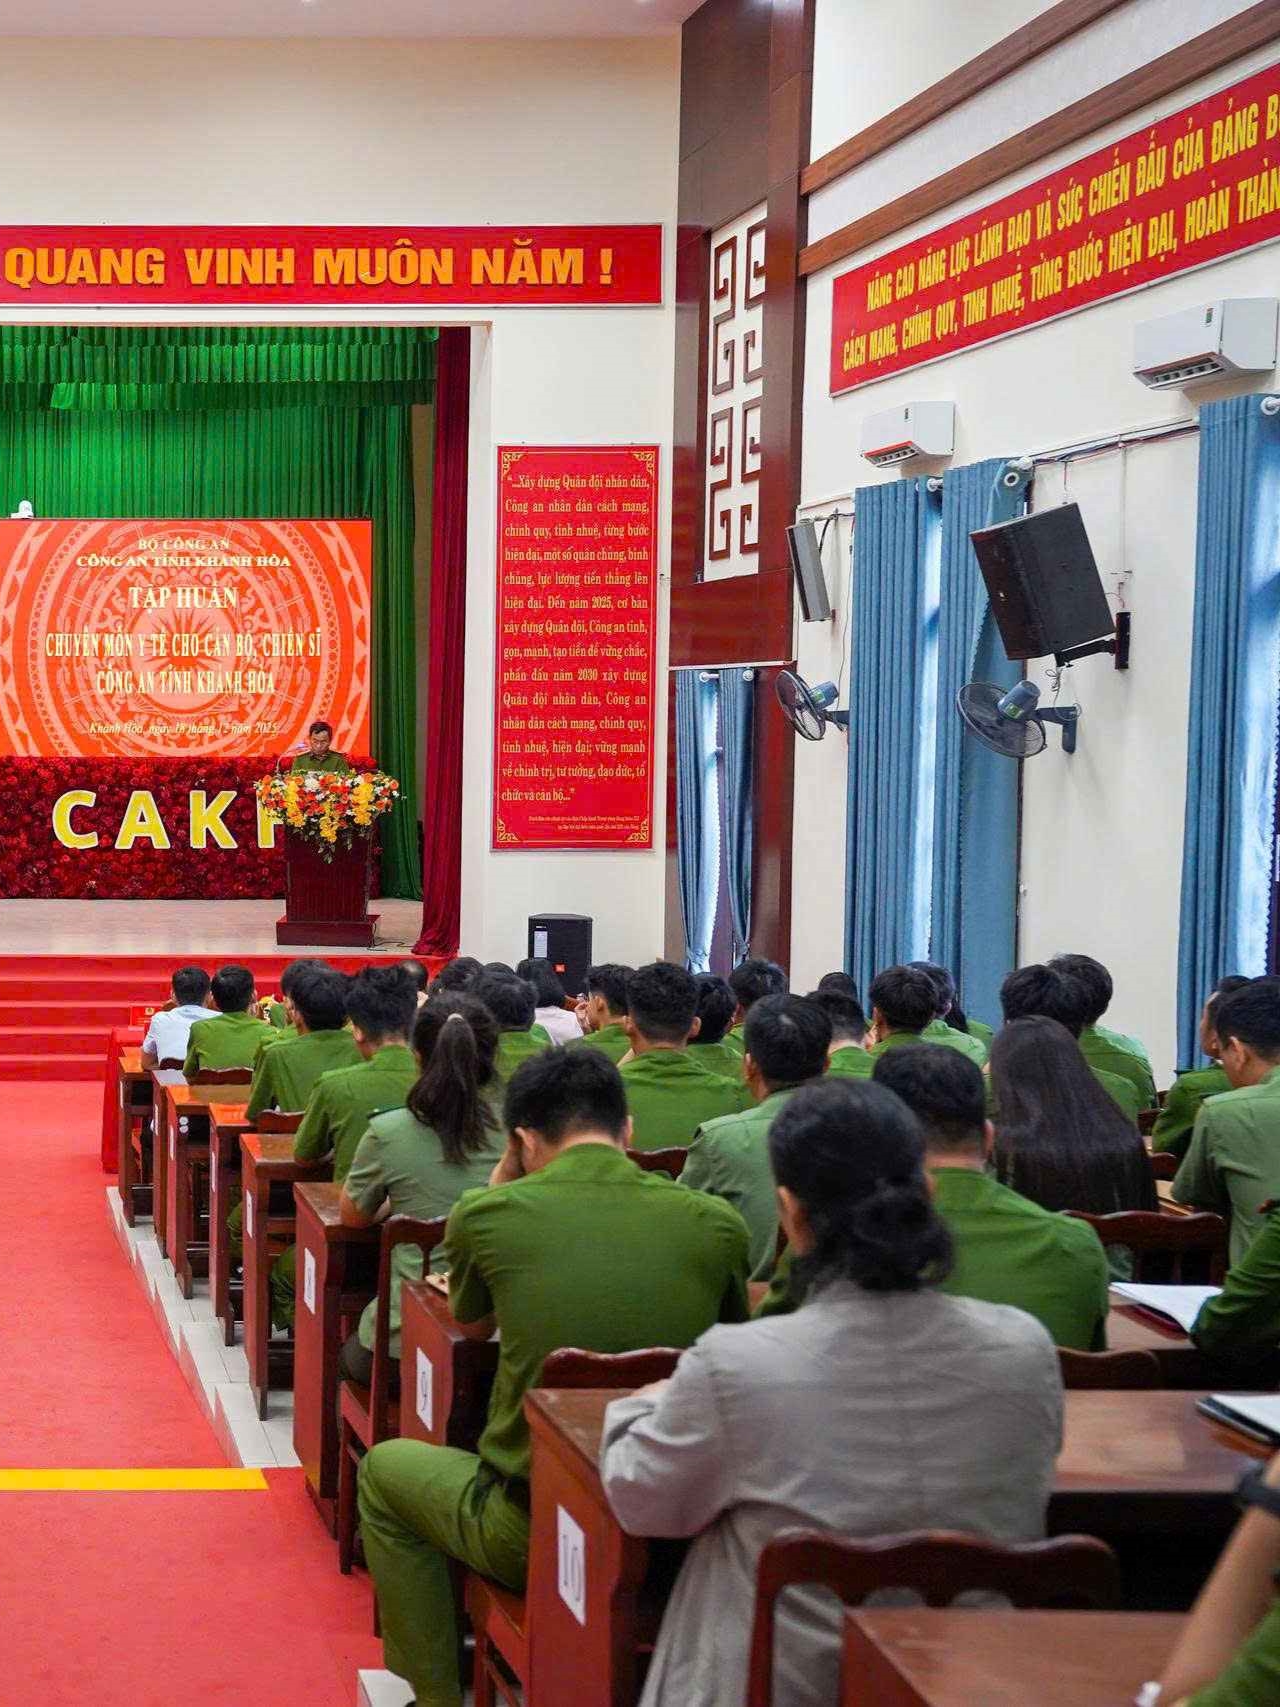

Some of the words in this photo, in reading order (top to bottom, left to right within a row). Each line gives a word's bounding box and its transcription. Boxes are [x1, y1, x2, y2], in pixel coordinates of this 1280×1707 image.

[896, 262, 915, 300] CAO
[949, 236, 970, 281] LỰC
[974, 220, 1003, 267] LÃNH
[1007, 209, 1031, 256] ĐẠO
[1036, 188, 1052, 240] VÀ
[1057, 177, 1084, 231] SỨC
[1088, 147, 1131, 217] CHIẾN
[1135, 129, 1167, 197] ĐẤU
[1172, 117, 1204, 180] CỦA
[1211, 98, 1259, 164] ĐẢNG
[5, 248, 164, 288] QUANG
[186, 249, 294, 284] VINH
[314, 239, 452, 284] MUÔN
[472, 239, 582, 283] NĂM
[601, 250, 611, 283] !
[843, 328, 866, 371] CÁCH
[869, 322, 898, 366] MẠNG,
[936, 299, 958, 340] QUY,
[962, 286, 987, 328] TINH
[991, 264, 1025, 317] NHUỆ,
[1030, 252, 1063, 302] TỪNG
[1067, 230, 1103, 288] BƯỚC
[1109, 217, 1143, 276] HIỆN
[1148, 209, 1178, 262] ĐẠI,
[1184, 179, 1231, 244] HOÀN
[128, 584, 172, 614] TẬP
[177, 578, 238, 609] HUẤN
[45, 624, 99, 657] CHUYÊN
[103, 625, 133, 657] MÔN
[137, 633, 145, 656] Y
[150, 625, 167, 657] TẾ
[172, 633, 199, 657] CHO
[204, 625, 231, 657] CÁN
[236, 628, 258, 662] BỘ,
[262, 625, 303, 657] CHIẾN
[308, 627, 321, 657] SĨ
